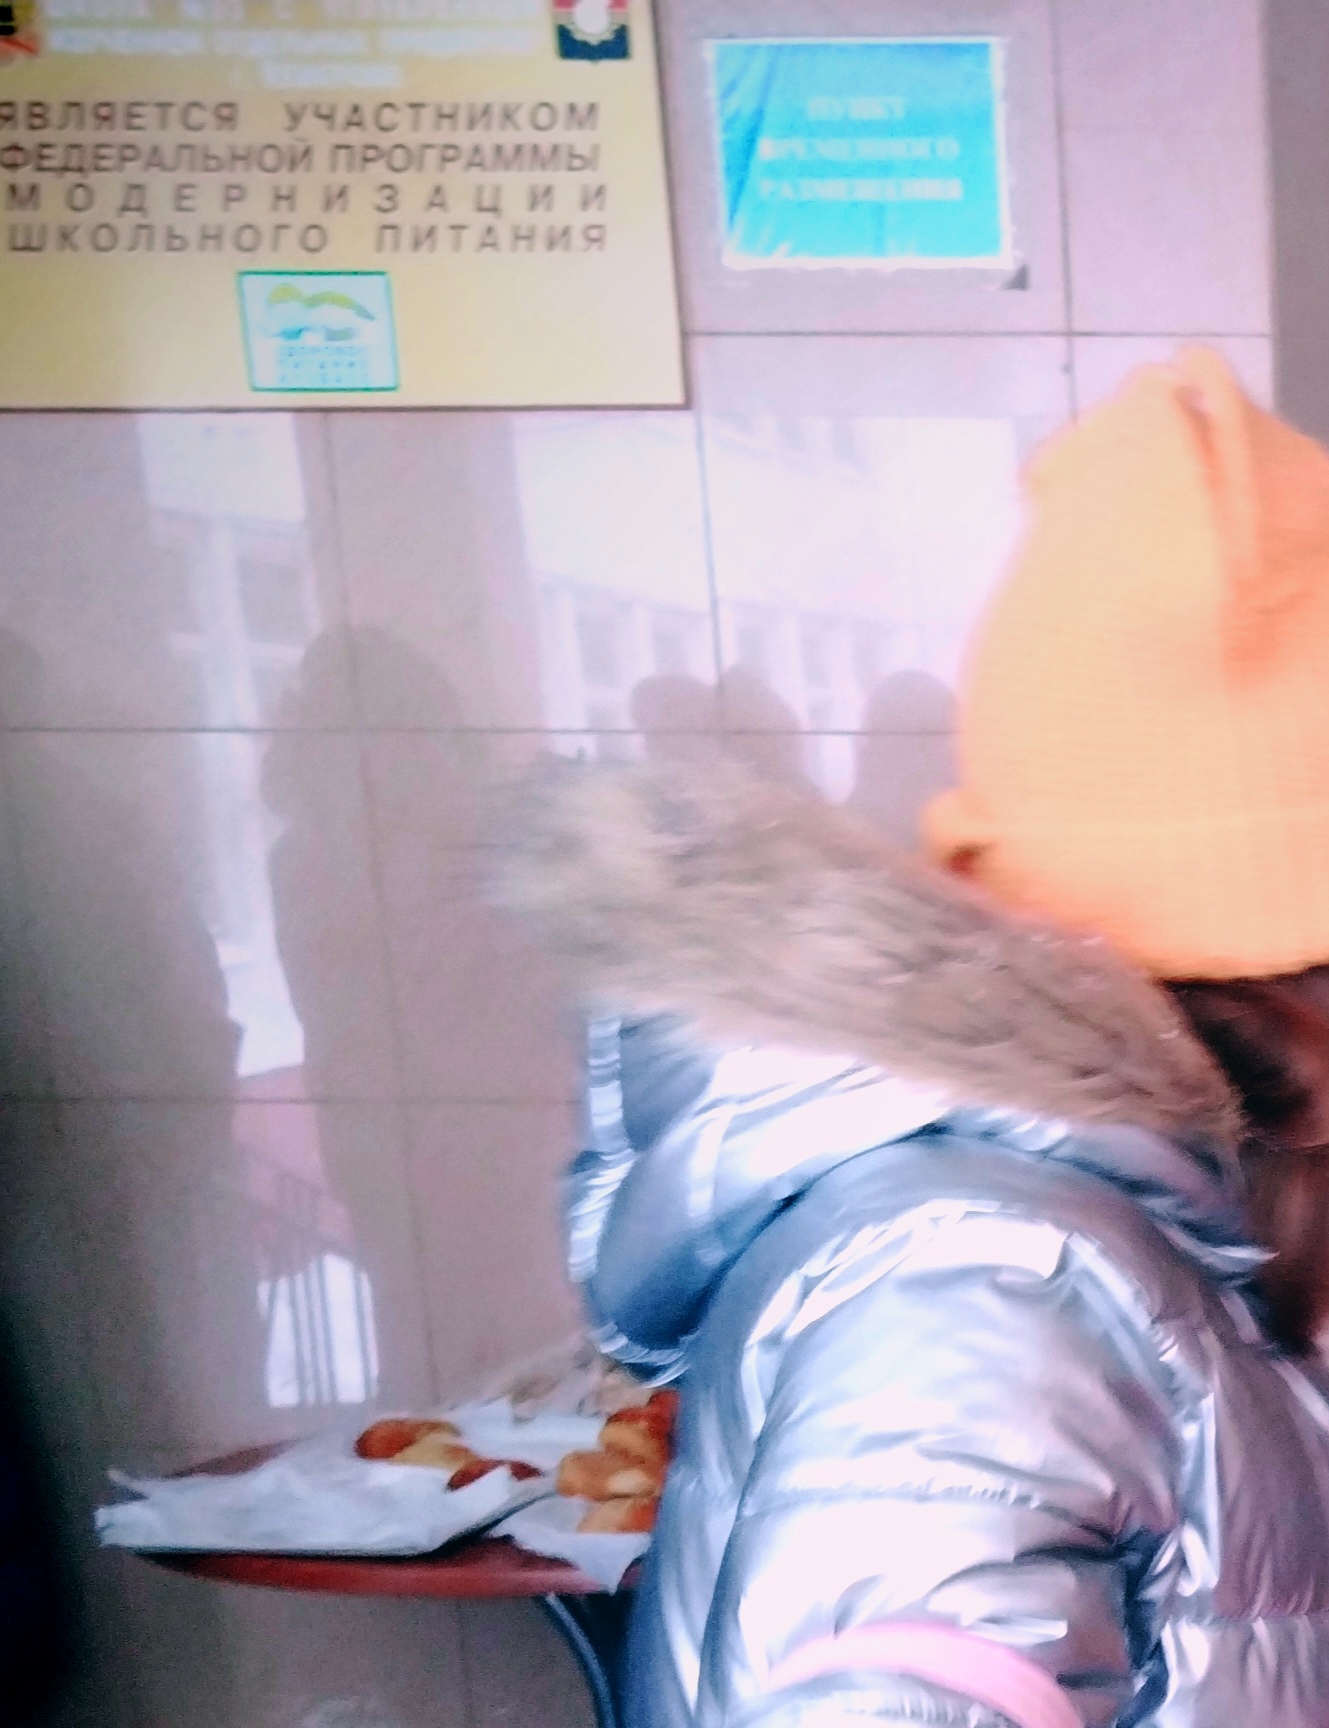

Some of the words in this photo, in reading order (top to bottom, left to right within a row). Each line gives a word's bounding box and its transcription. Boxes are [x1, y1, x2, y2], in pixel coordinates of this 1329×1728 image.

[0, 101, 238, 131] ЯВЛЯЕТСЯ
[284, 101, 598, 132] УЧАСТНИКОМ
[0, 137, 313, 177] ФЕДЕРАЛЬНОЙ
[329, 143, 601, 174] ПРОГРАММЫ
[8, 182, 606, 219] МОДЕРНИЗАЦИИ
[8, 223, 328, 252] ШКОЛЬНОГО
[376, 223, 605, 252] ПИТАНИЯ
